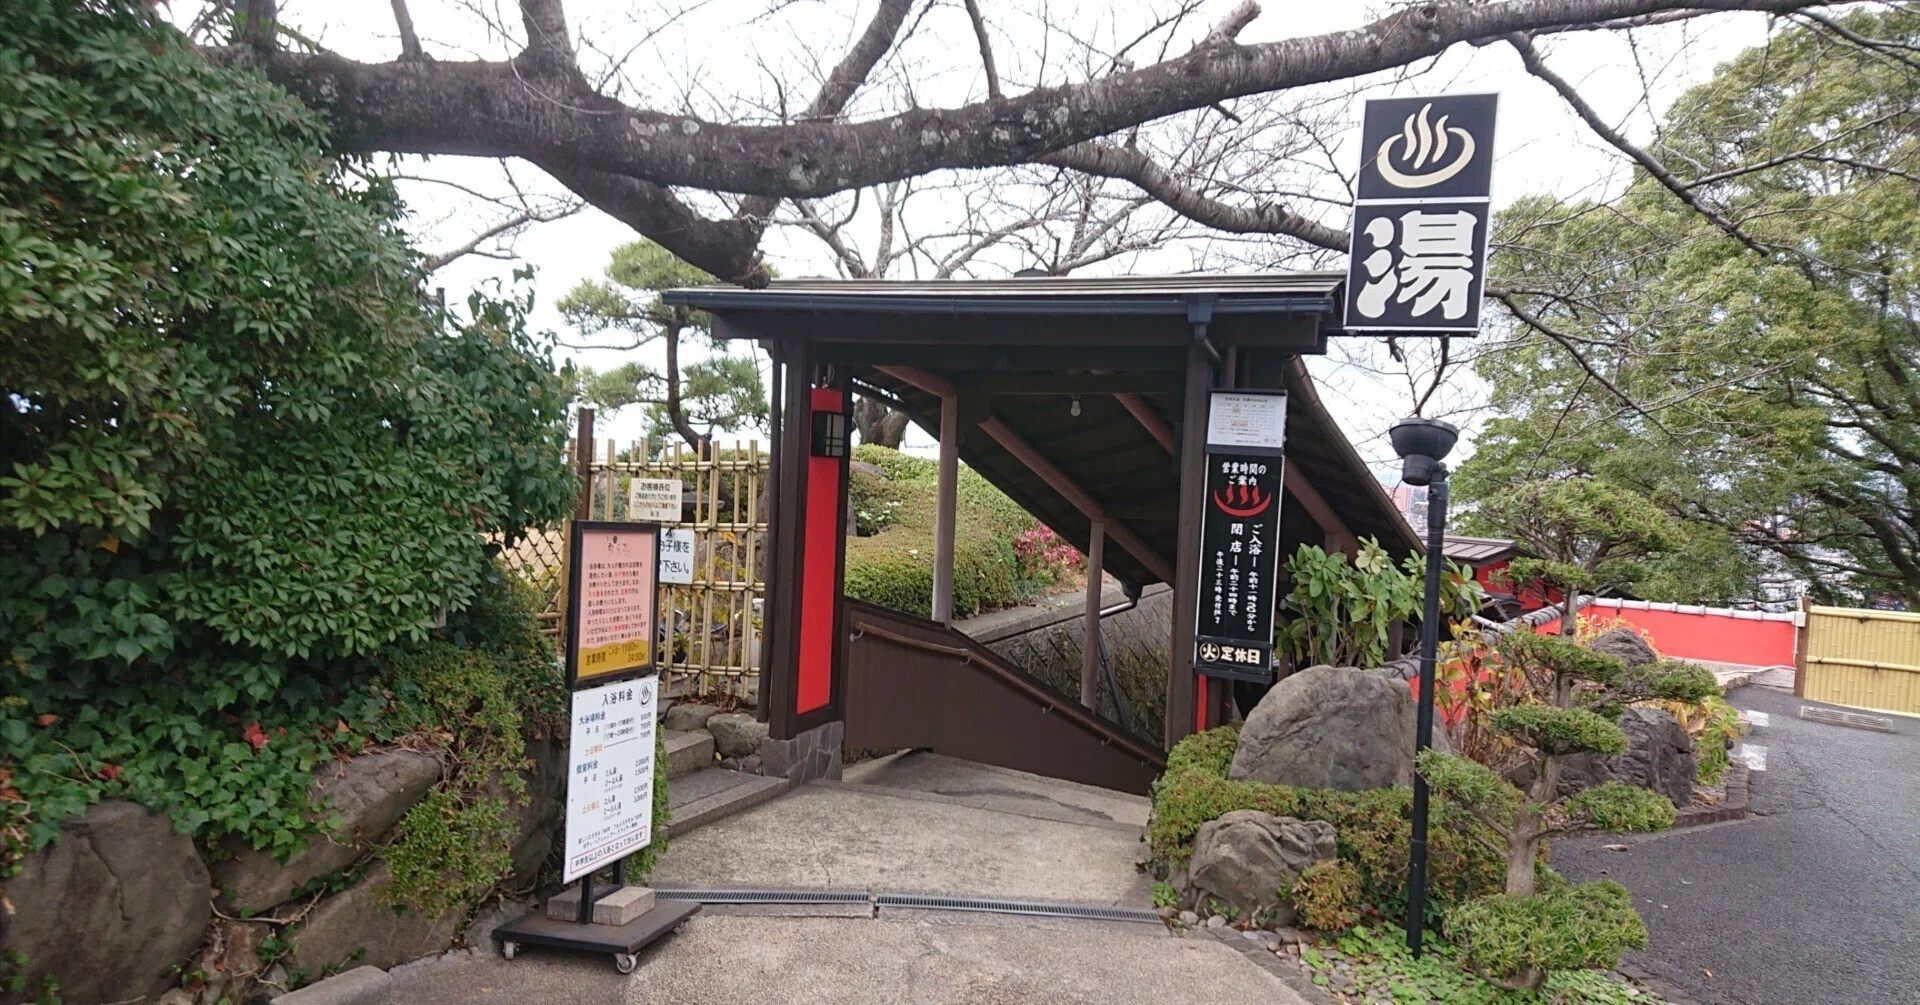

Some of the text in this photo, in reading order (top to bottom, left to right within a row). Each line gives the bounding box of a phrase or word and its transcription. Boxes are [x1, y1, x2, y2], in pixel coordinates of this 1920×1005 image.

[1357, 209, 1477, 320] 湯
[1222, 461, 1267, 475] 営業時間の
[1228, 474, 1257, 486] ご案内
[1220, 646, 1260, 665] 定休日
[602, 688, 633, 706] 入浴料金
[578, 710, 606, 726] 大浴場料金
